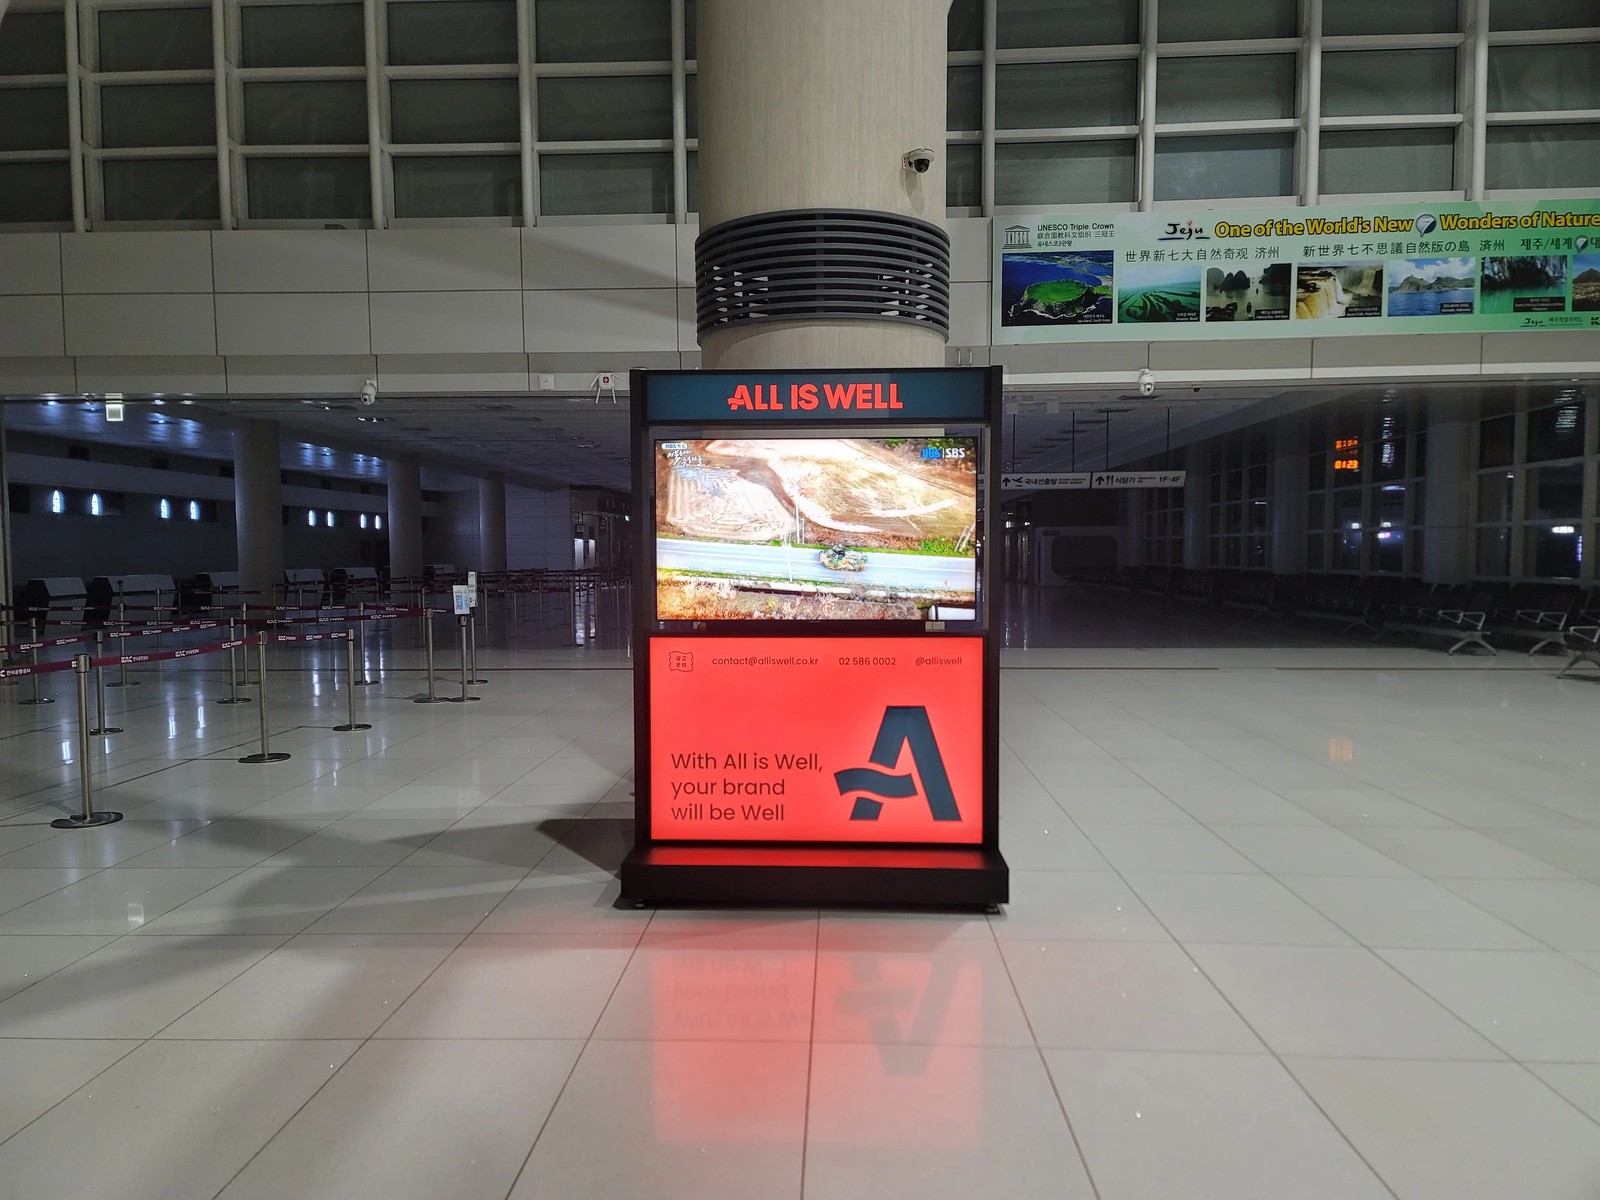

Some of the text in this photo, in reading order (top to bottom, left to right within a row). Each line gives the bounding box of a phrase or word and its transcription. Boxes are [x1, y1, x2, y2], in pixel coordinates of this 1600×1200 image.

[1037, 222, 1114, 232] UNESCO Triple Crown
[1215, 221, 1251, 238] One
[1253, 219, 1275, 237] of
[1275, 218, 1305, 236] the
[1306, 216, 1370, 235] World's
[1373, 215, 1414, 233] New
[1439, 212, 1518, 231] Wonders
[1520, 210, 1541, 228] of
[1541, 210, 1600, 228] Nature
[1125, 246, 1281, 263] 世界新七大自然奇观 济州
[727, 383, 904, 411] ALL IS WELL
[945, 447, 966, 459] SBS
[711, 656, 819, 667] contact@alliswell.co.kr
[838, 657, 896, 666] 02 586 0002
[915, 656, 962, 667] @alliswell
[671, 753, 823, 772] With All is Well,
[671, 779, 785, 800] your brand
[671, 803, 784, 821] will be Well
